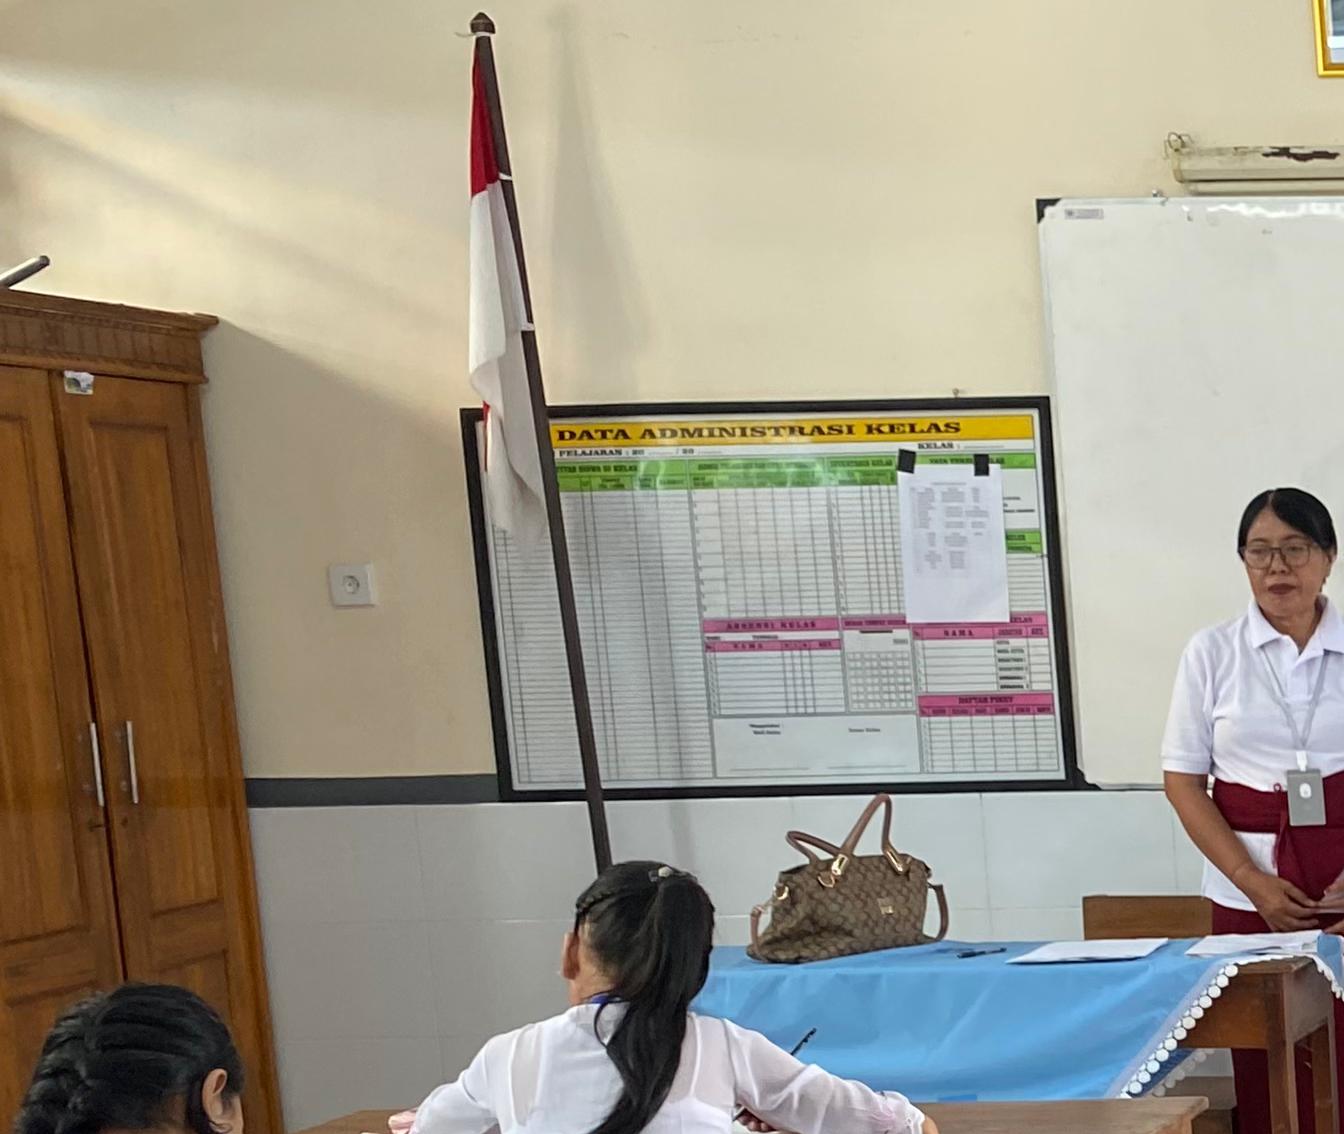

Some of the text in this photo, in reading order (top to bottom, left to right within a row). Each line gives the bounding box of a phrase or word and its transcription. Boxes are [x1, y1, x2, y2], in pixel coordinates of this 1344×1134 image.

[557, 421, 961, 441] DATA ADMINISTRASI KELAS
[559, 449, 623, 457] PELAJARAN
